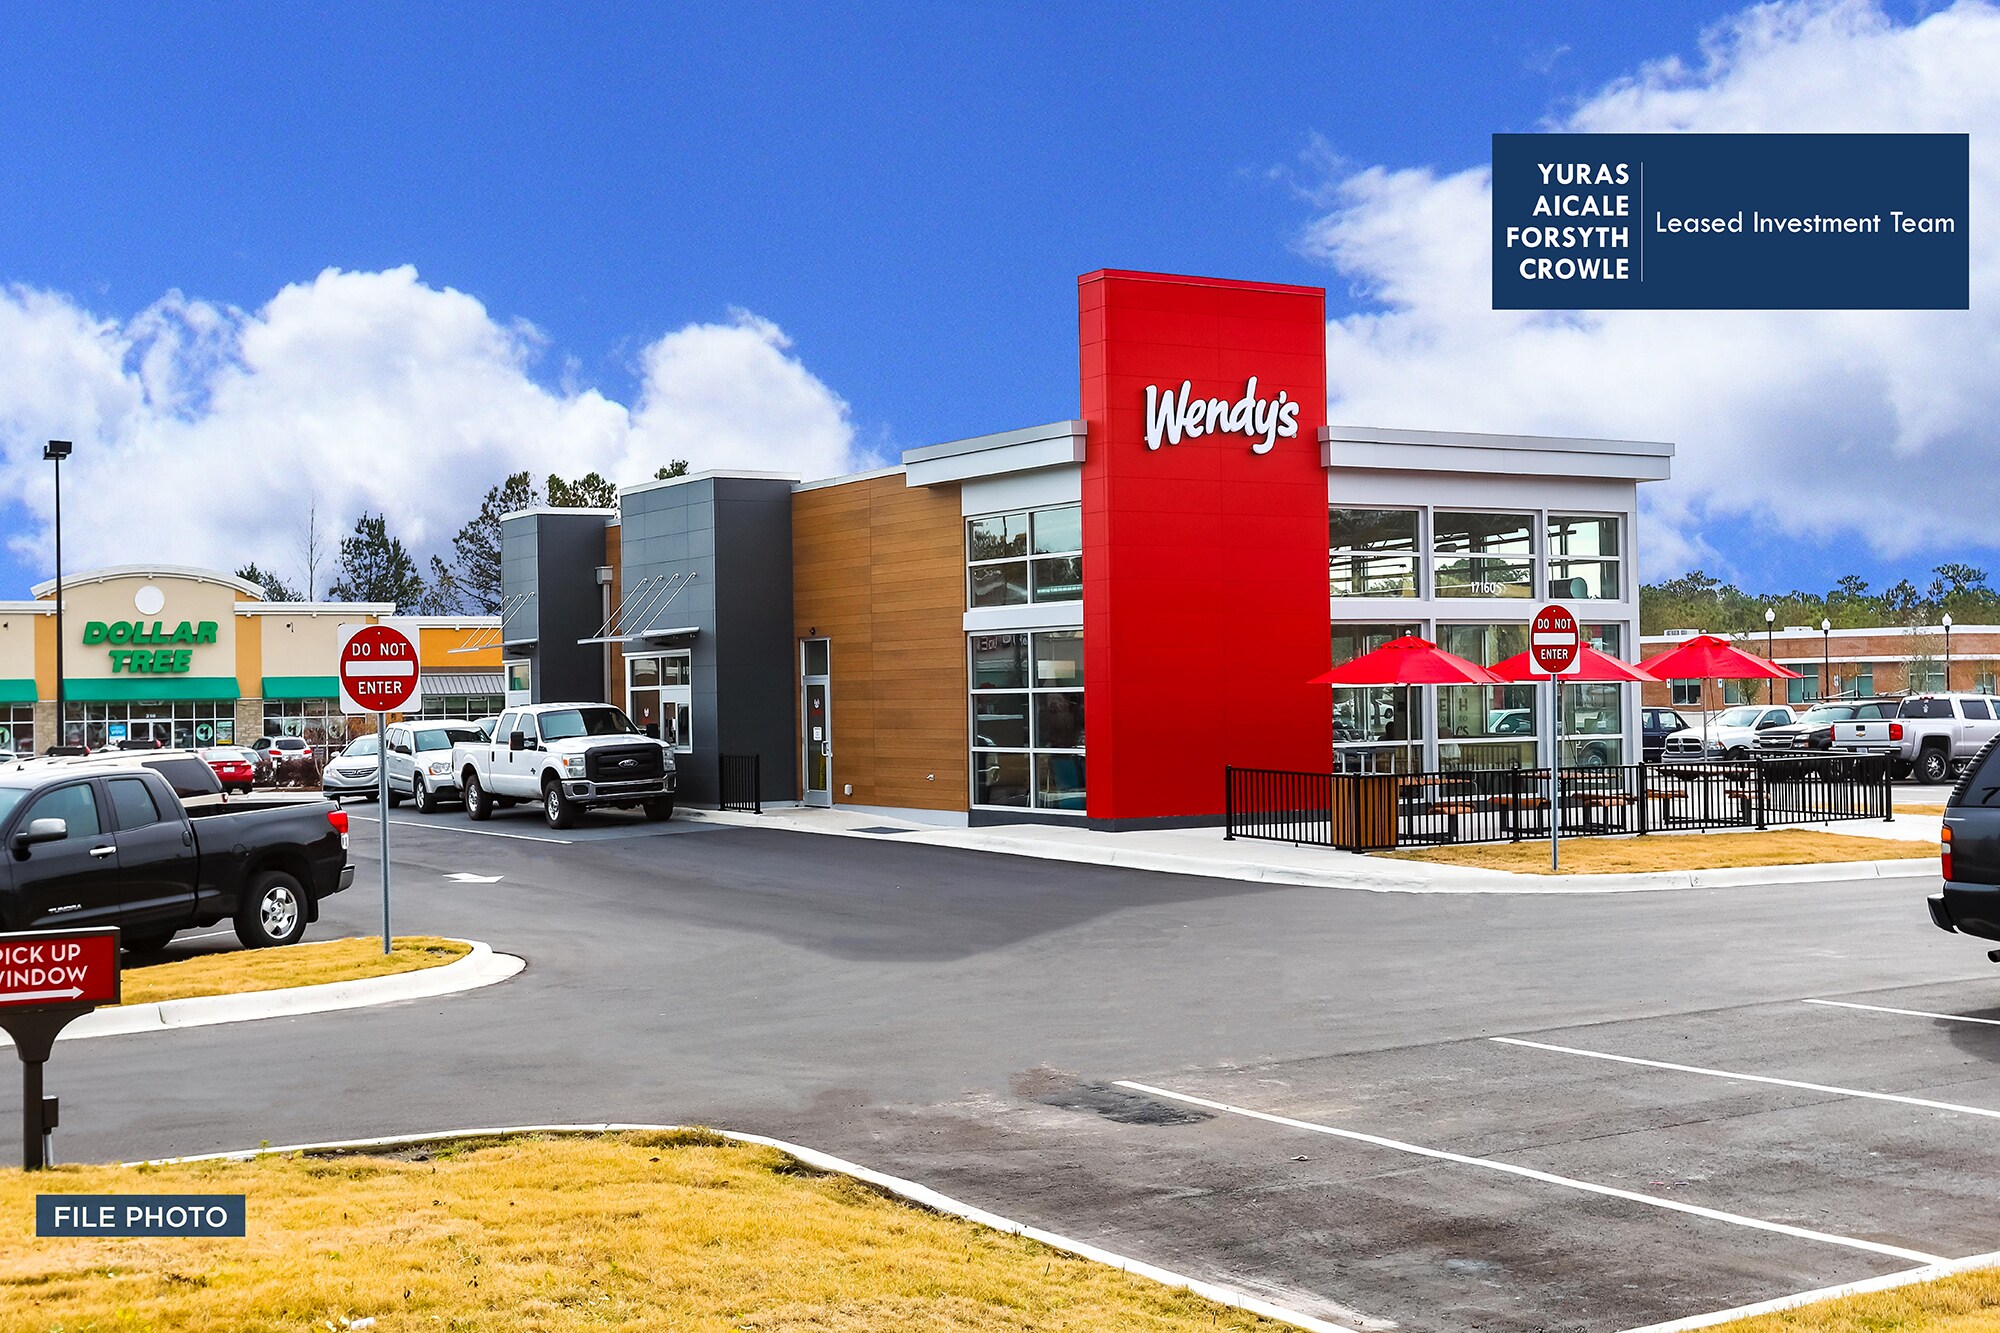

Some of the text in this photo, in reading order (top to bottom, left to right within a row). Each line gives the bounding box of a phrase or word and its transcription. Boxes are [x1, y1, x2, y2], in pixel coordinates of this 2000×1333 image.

[1145, 375, 1300, 455] Wendy's
[1471, 581, 1496, 594] 17160
[82, 620, 219, 646] DOLLAR
[1537, 618, 1572, 630] DO NOT
[352, 643, 407, 657] DO NOT
[1541, 648, 1569, 660] ENTER
[108, 649, 193, 674] TREE
[358, 681, 402, 695] ENTER
[0, 944, 81, 966] ICK UP
[0, 965, 88, 987] INDOW
